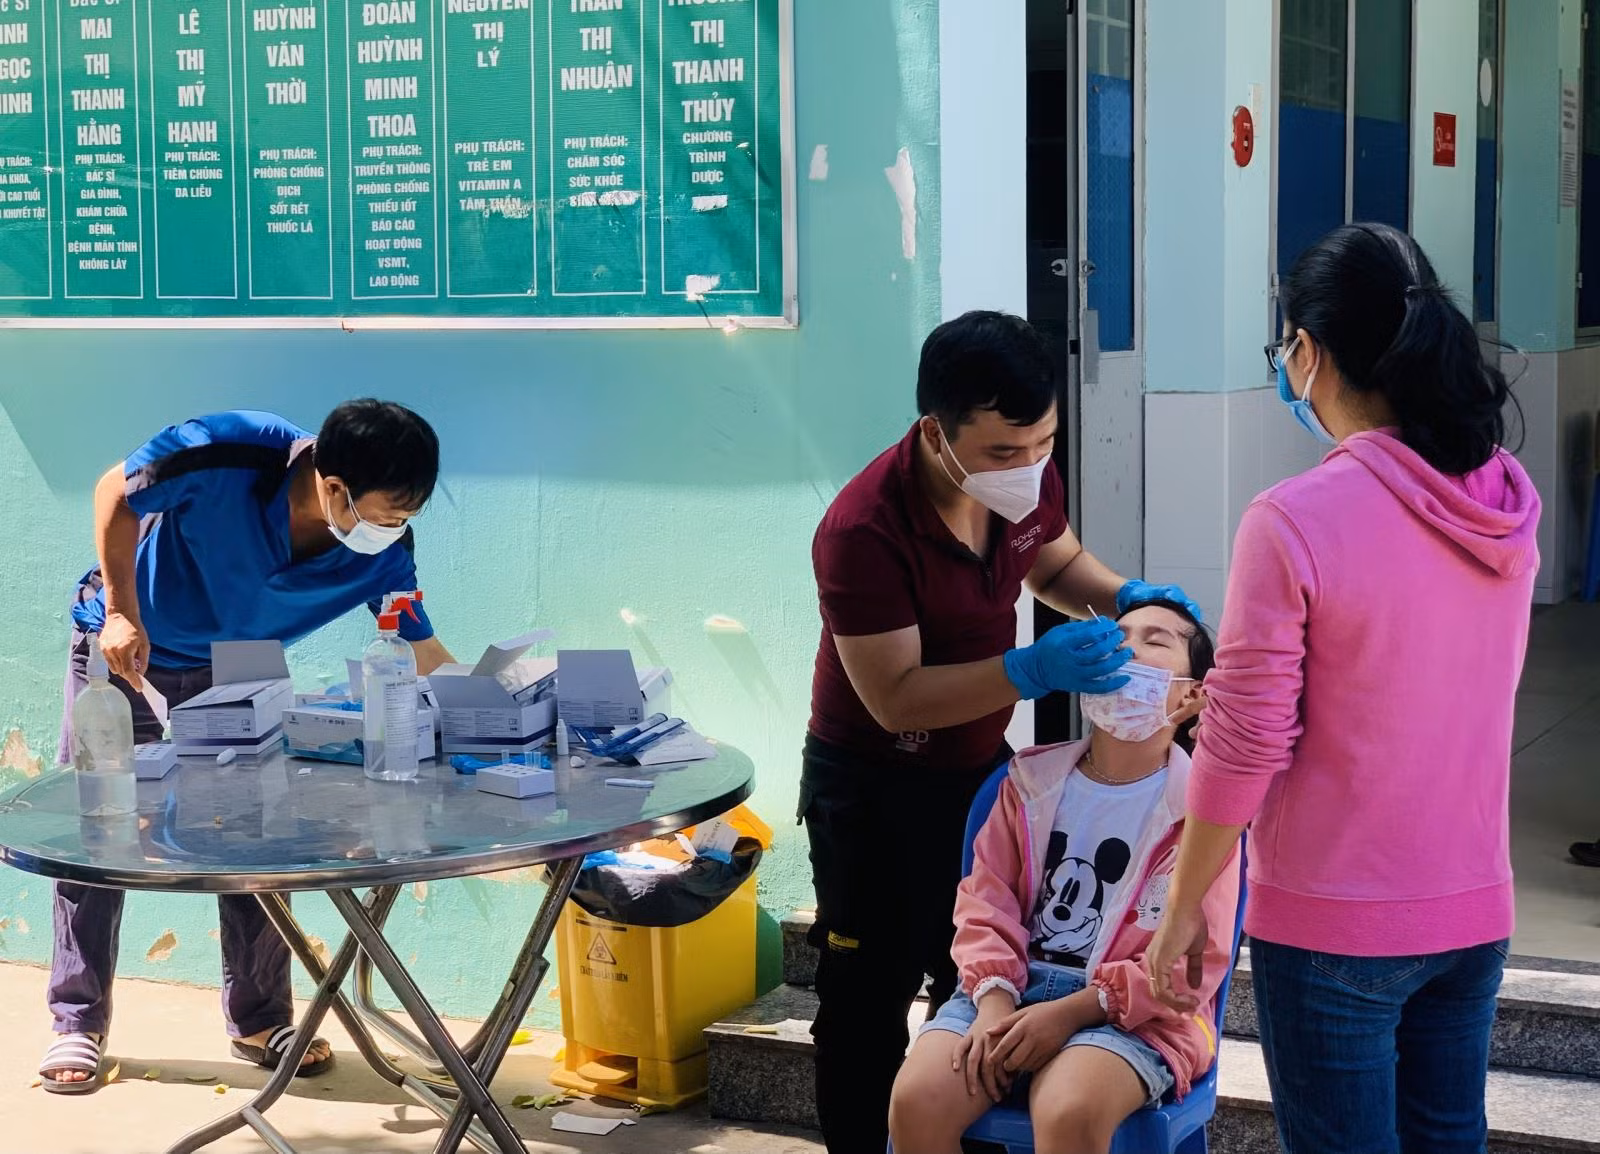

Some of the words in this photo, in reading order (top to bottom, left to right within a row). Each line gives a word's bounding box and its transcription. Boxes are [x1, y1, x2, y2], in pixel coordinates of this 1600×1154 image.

[179, 9, 200, 35] LÊ
[253, 6, 316, 31] HUỲNH
[80, 17, 112, 40] MAI
[472, 21, 504, 43] THỊ
[690, 19, 724, 48] THỊ
[580, 26, 612, 55] THỊ
[266, 42, 304, 67] VĂN
[357, 35, 423, 64] HUỲNH
[476, 46, 500, 68] LÝ
[84, 53, 110, 79] THỊ
[176, 49, 205, 75] THỊ
[560, 61, 633, 93] NHUẬN
[672, 58, 744, 85] THANH
[178, 81, 206, 107] MỸ
[265, 77, 307, 105] THỜI
[364, 76, 418, 101] MINH
[0, 92, 32, 115] INH
[71, 88, 125, 111] THANH
[681, 91, 735, 123] THỦY
[77, 118, 121, 146] HẰNG
[168, 121, 217, 147] HẠNH
[367, 114, 417, 138] THOA
[362, 146, 383, 159] PHỤ
[385, 143, 422, 157] TRÁCH:
[454, 142, 479, 156] PHỤ
[483, 139, 525, 153] TRÁCH:
[564, 136, 586, 151] PHỤ
[590, 135, 629, 149] TRÁCH:
[75, 154, 93, 166] PHỤ
[95, 152, 125, 164] TRÁCH:
[165, 151, 185, 164] PHỤ
[187, 149, 220, 162] TRÁCH:
[260, 150, 280, 162] PHỤ
[283, 147, 317, 160] TRÁCH:
[602, 153, 625, 167] SÓC
[689, 149, 726, 164] TRÌNH
[254, 167, 287, 178] PHÒNG
[290, 164, 324, 178] CHỐNG
[395, 161, 431, 176] THÔNG
[493, 159, 512, 172] EM
[86, 170, 104, 182] BÁC
[175, 187, 188, 198] DA
[277, 185, 300, 198] DỊCH
[356, 181, 392, 195] PHÒNG
[394, 178, 430, 193] CHỐNG
[458, 178, 510, 192] VITAMIN
[513, 178, 522, 190] A
[8, 191, 22, 202] CAO
[81, 188, 96, 199] GIA
[77, 205, 102, 217] KHÁM
[270, 201, 288, 215] SỐT
[368, 198, 398, 213] THIẾU
[266, 219, 298, 233] THUỐC
[371, 218, 392, 232] BÁO
[394, 217, 415, 231] CÁO
[68, 240, 92, 254] BỆNH
[117, 240, 137, 253] TÍNH
[365, 239, 392, 252] HOẠT
[393, 236, 422, 251] ĐỘNG
[80, 258, 109, 270] KHÔNG
[369, 275, 389, 287] LAO
[390, 273, 420, 289] ĐỘNG
